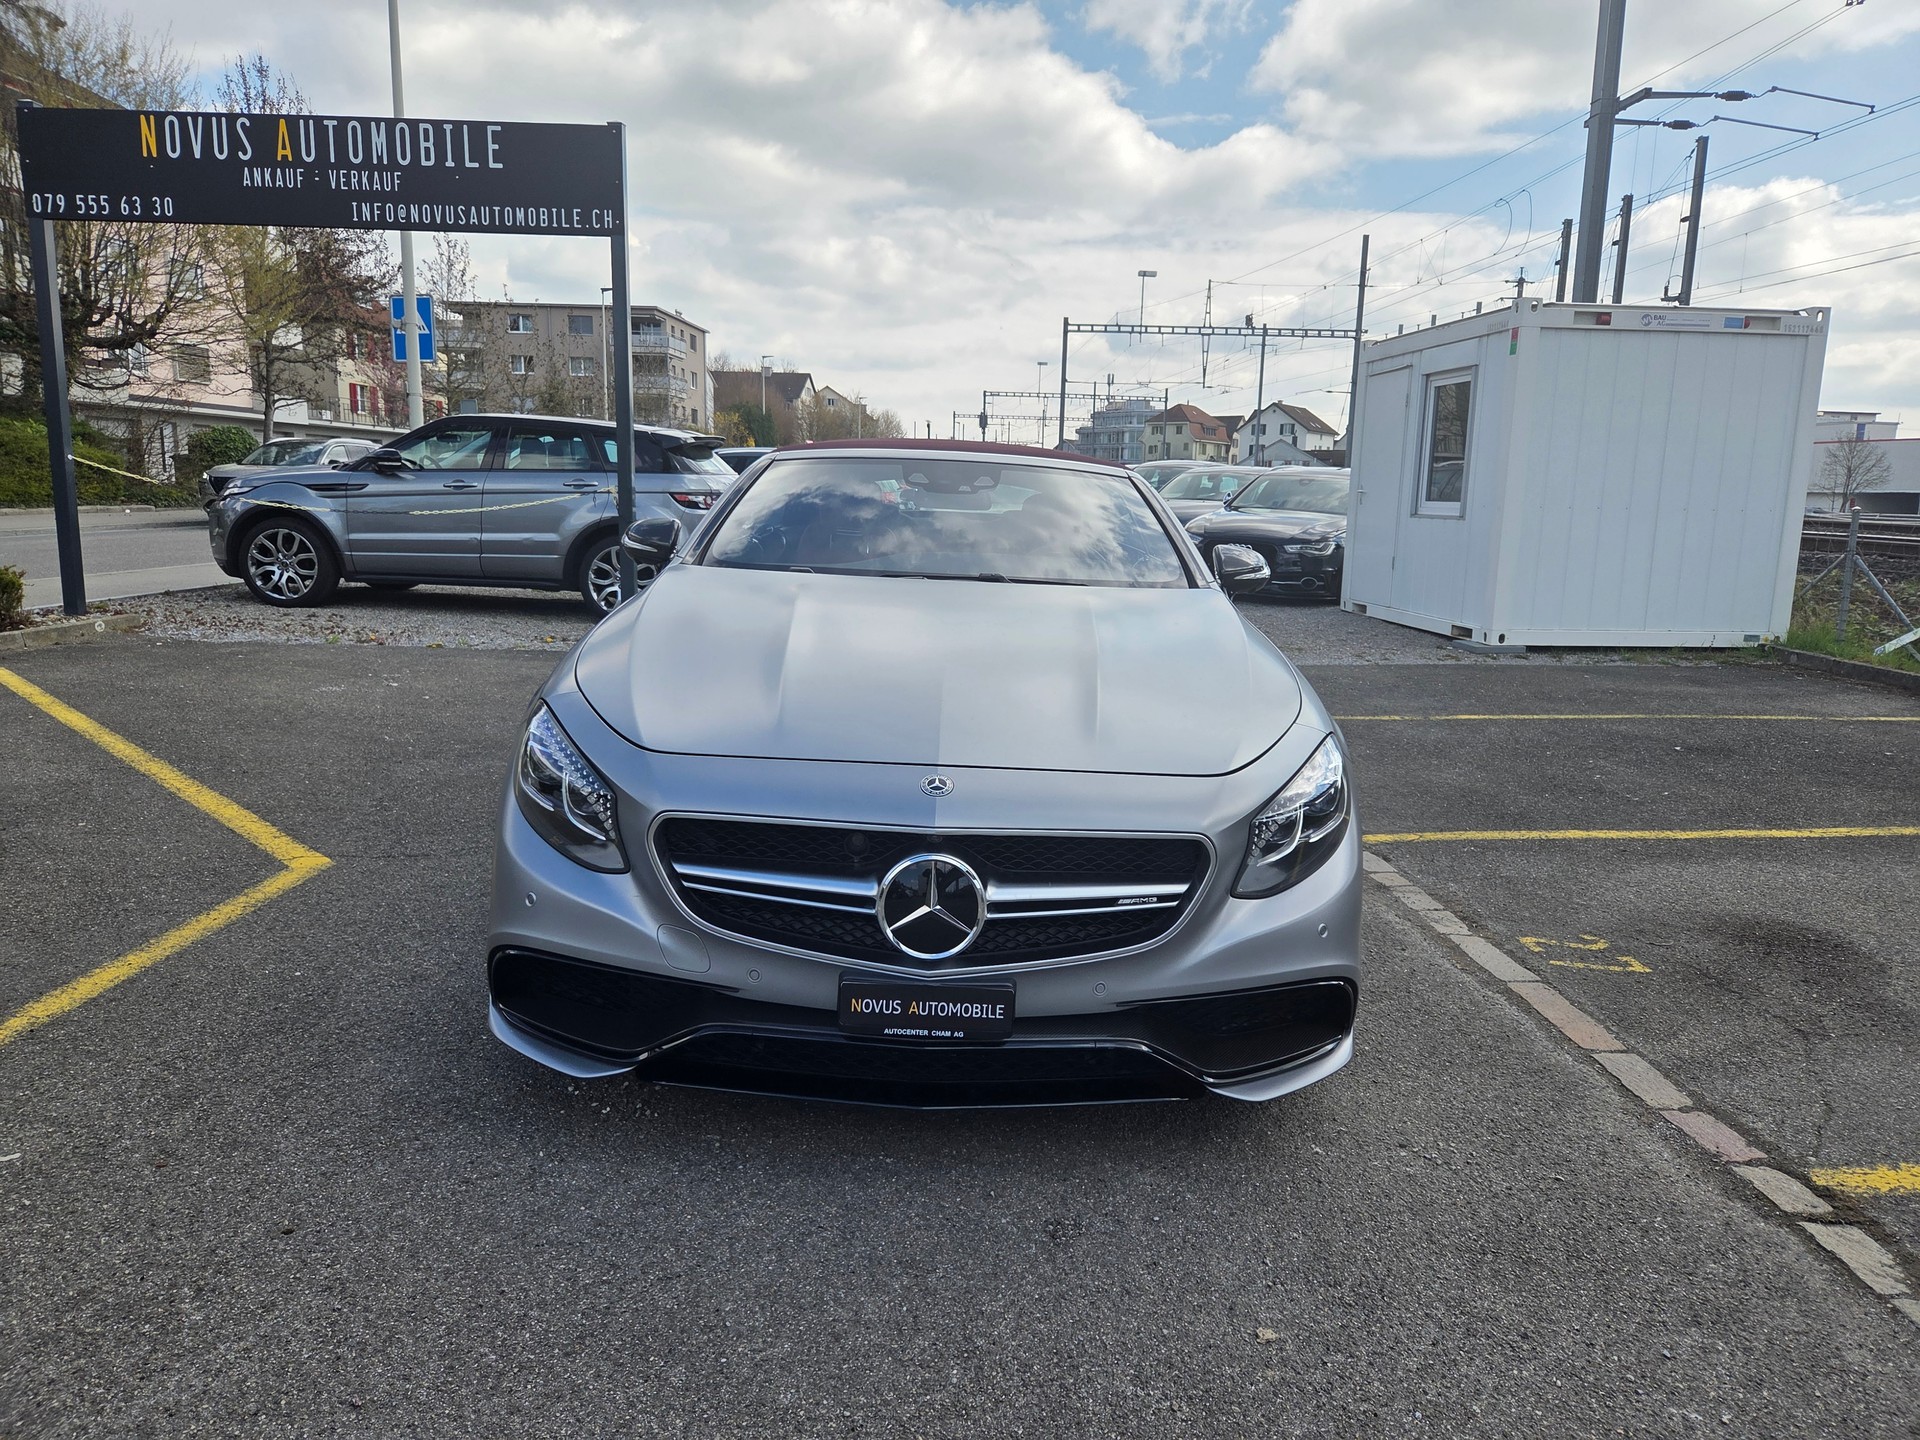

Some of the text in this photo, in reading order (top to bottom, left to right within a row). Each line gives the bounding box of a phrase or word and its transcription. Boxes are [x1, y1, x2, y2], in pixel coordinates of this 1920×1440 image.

[140, 114, 503, 169] NOVUS AUTOMOBILE
[243, 167, 304, 188] ANKAUF
[328, 169, 402, 192] VERKAUF
[32, 193, 173, 217] 079 555 63 30
[351, 202, 613, 229] INFO@NOVUSAUTOMOBILE.CH
[851, 998, 1005, 1019] NOVUS AUTOMOBILE
[884, 1028, 929, 1036] AUTOCENTER
